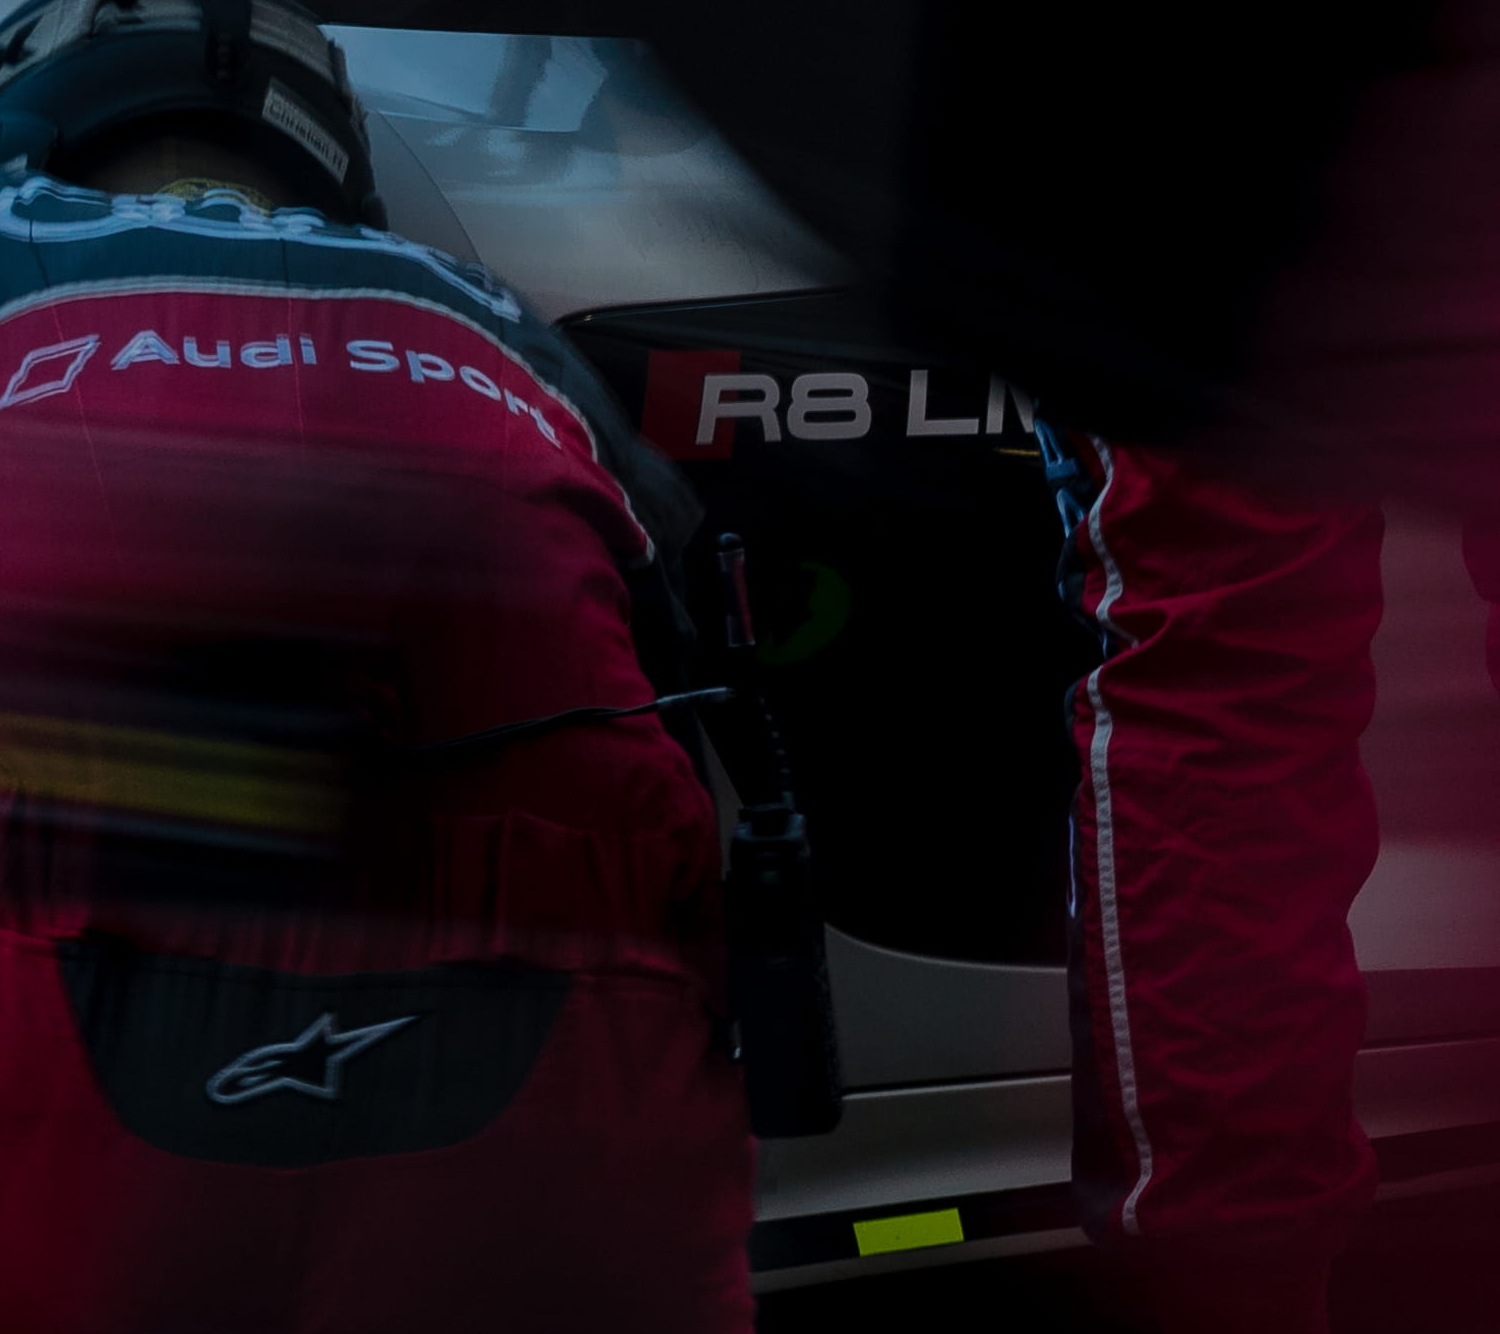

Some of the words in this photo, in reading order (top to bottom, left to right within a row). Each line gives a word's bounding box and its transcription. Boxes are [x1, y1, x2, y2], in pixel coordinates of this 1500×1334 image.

[111, 330, 318, 371] Audi
[346, 339, 563, 450] Sport
[695, 371, 873, 446] R8
